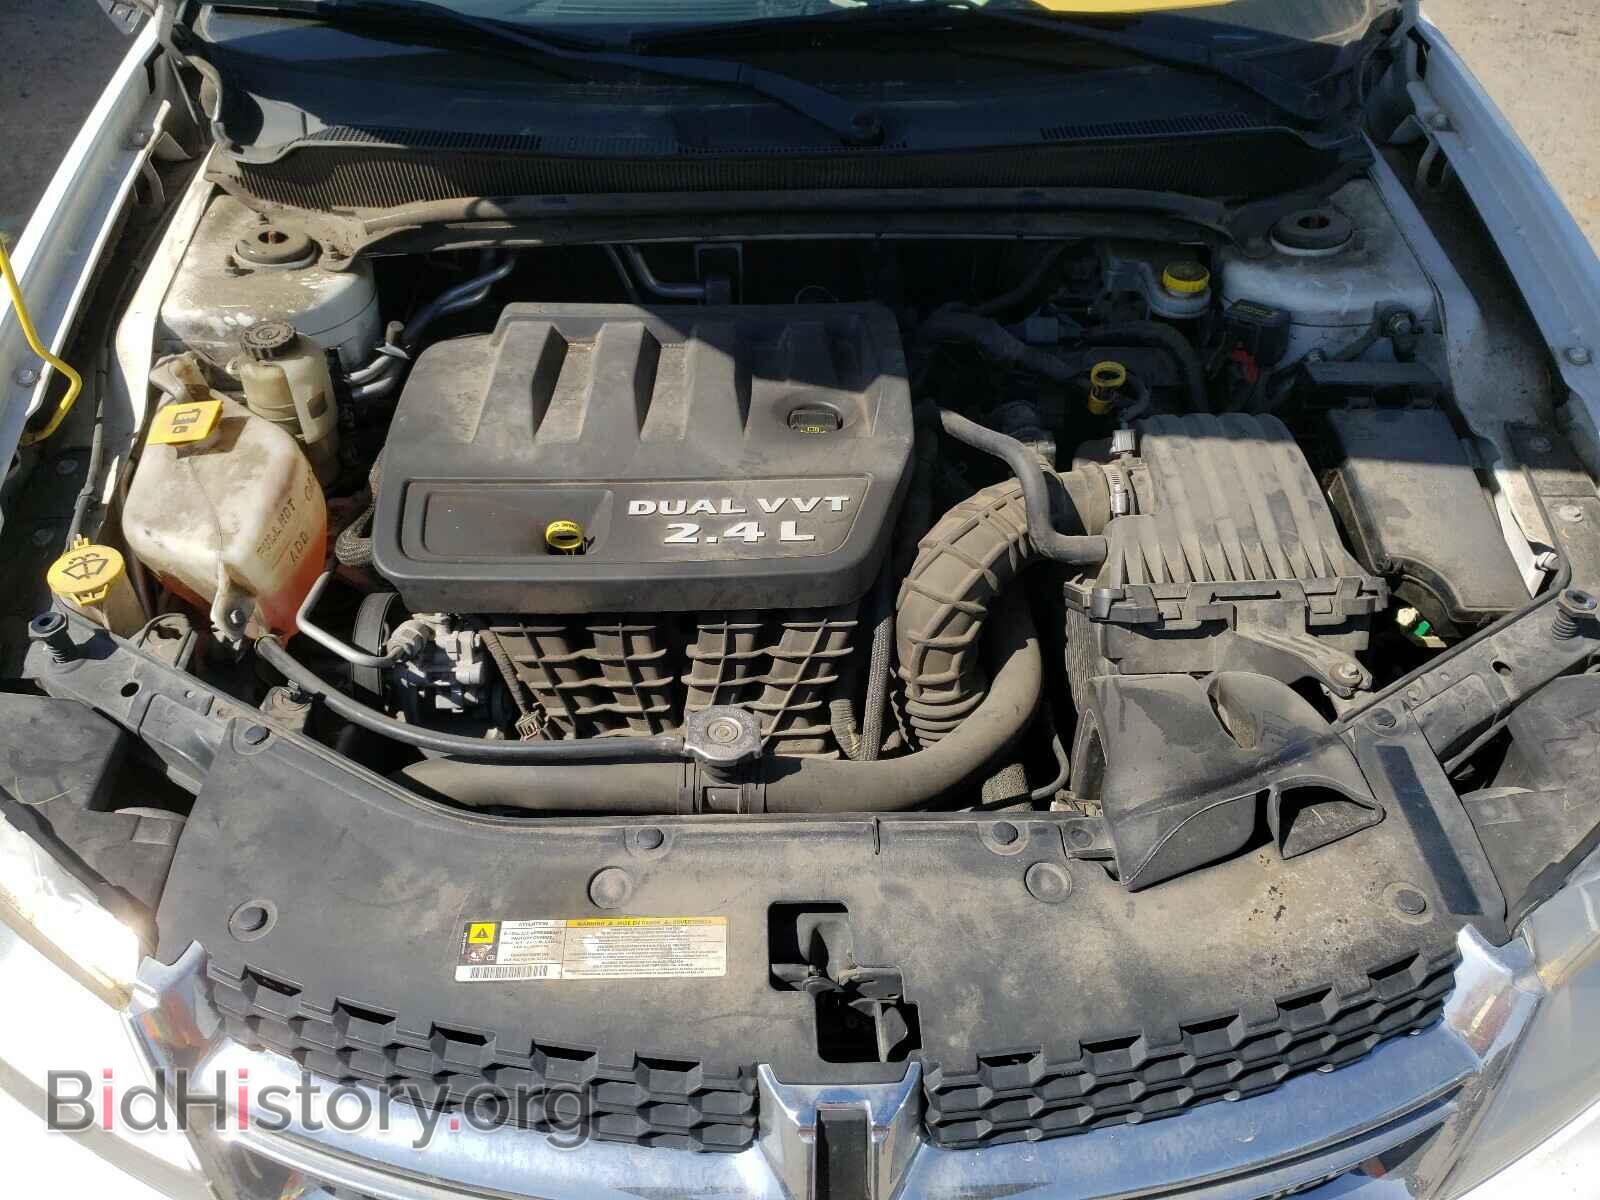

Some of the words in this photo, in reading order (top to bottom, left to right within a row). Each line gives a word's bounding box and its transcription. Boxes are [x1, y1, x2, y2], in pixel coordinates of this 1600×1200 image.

[628, 499, 746, 515] DUAL
[757, 496, 850, 513] VVT
[287, 530, 310, 568] ADD
